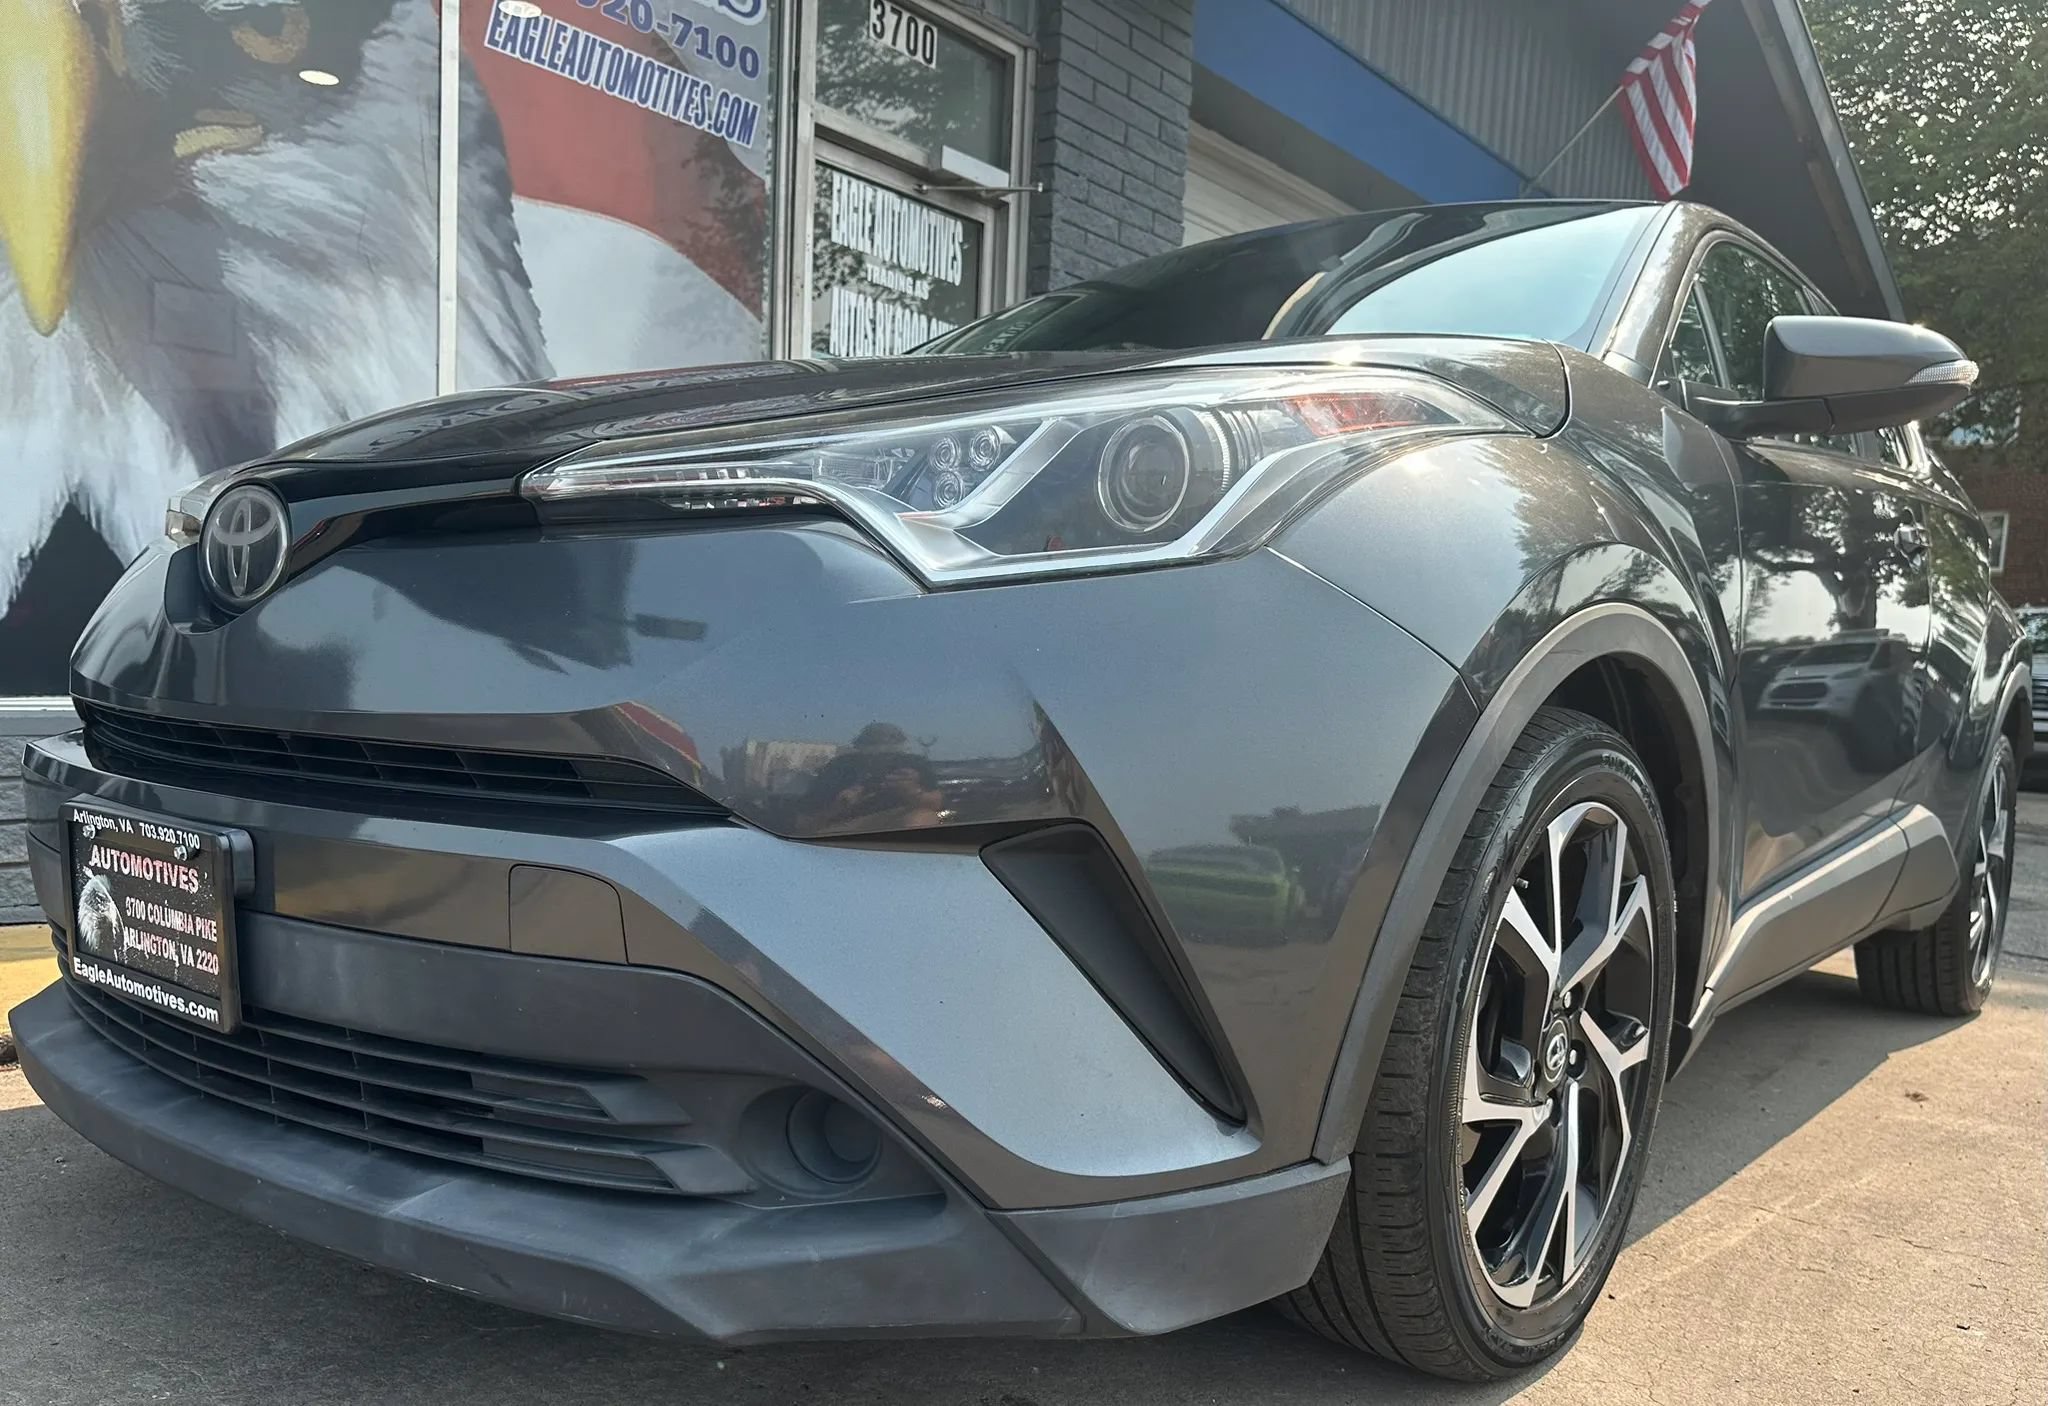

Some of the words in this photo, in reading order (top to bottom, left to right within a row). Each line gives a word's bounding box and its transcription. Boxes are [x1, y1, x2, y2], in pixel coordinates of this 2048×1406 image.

[577, 0, 760, 79] 20-7100
[872, 0, 935, 65] 3700
[486, 8, 759, 147] EAGLEAUTOMOTIVES.COM
[831, 171, 874, 254] EAGLE
[873, 187, 963, 287] AUTOMOTIVES
[866, 263, 913, 297] TRADING
[914, 279, 930, 301] AS
[829, 286, 875, 357] AUTOS
[73, 808, 119, 833] Arlington,
[118, 819, 134, 834] VA
[139, 822, 200, 850] 703.920.7100
[89, 844, 199, 895] AUTOMOTIVES
[125, 896, 146, 921] 3700
[149, 902, 195, 936] COLUMBIA
[195, 915, 217, 943] PIKE
[180, 943, 195, 967] VA
[73, 956, 219, 1025] EagleAutomotives.com
